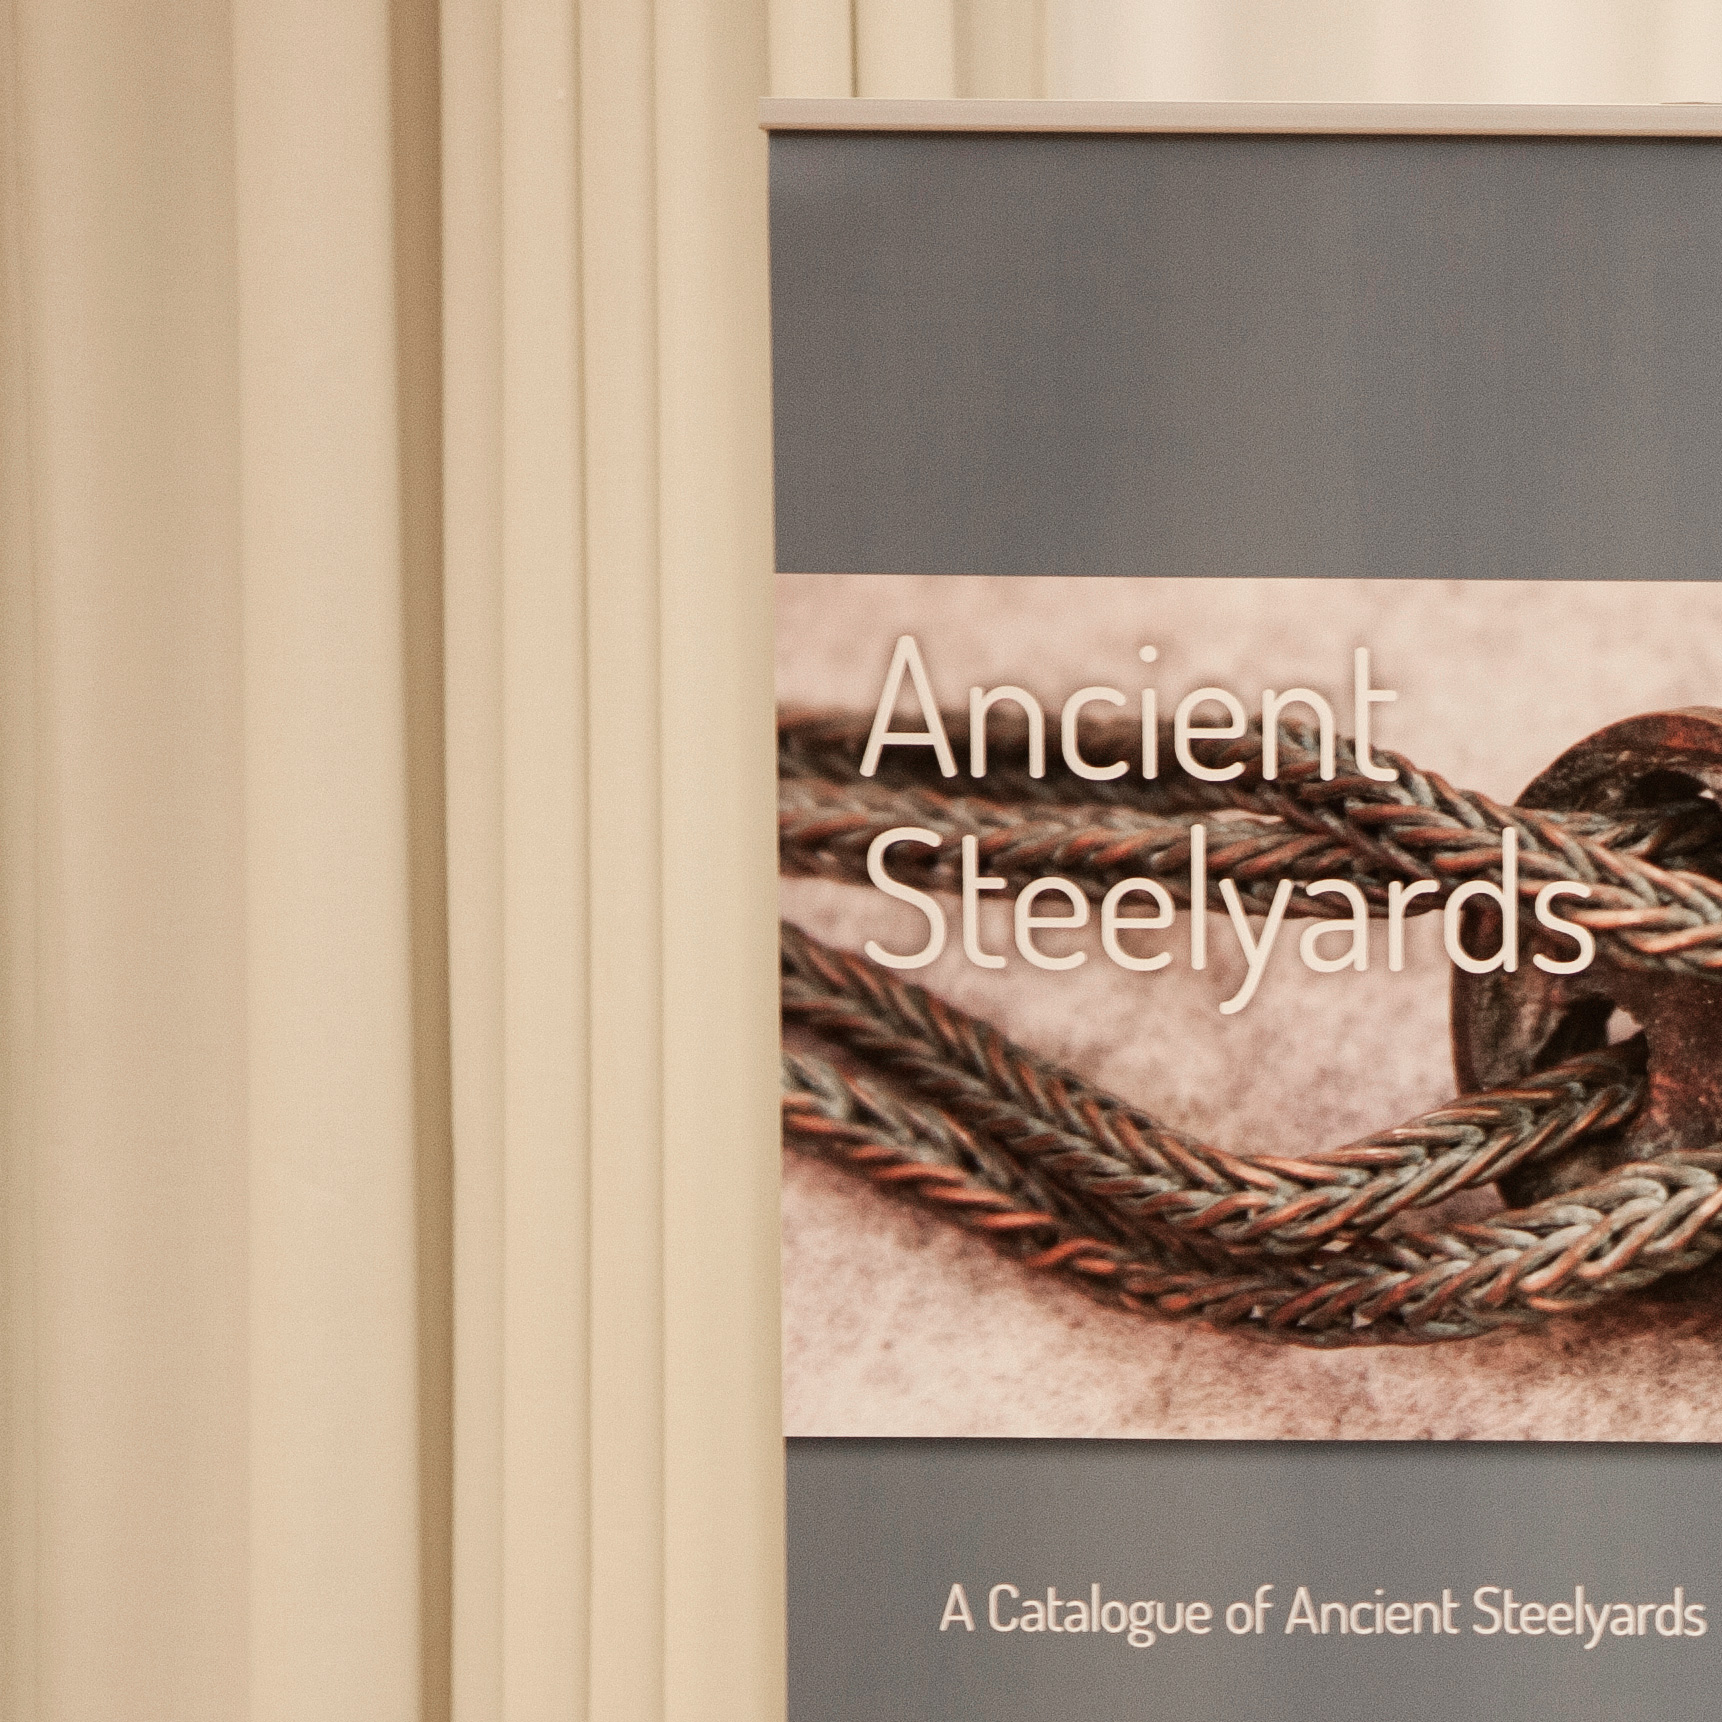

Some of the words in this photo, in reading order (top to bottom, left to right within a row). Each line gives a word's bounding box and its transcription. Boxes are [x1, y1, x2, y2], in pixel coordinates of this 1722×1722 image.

[859, 634, 1399, 782] Ancient
[863, 824, 1597, 1016] Steelyards
[940, 1582, 976, 1632] A
[989, 1582, 1214, 1649] Catalogue
[1226, 1583, 1274, 1636] of
[1285, 1585, 1461, 1636] Ancient
[1473, 1585, 1709, 1650] Steelyards
